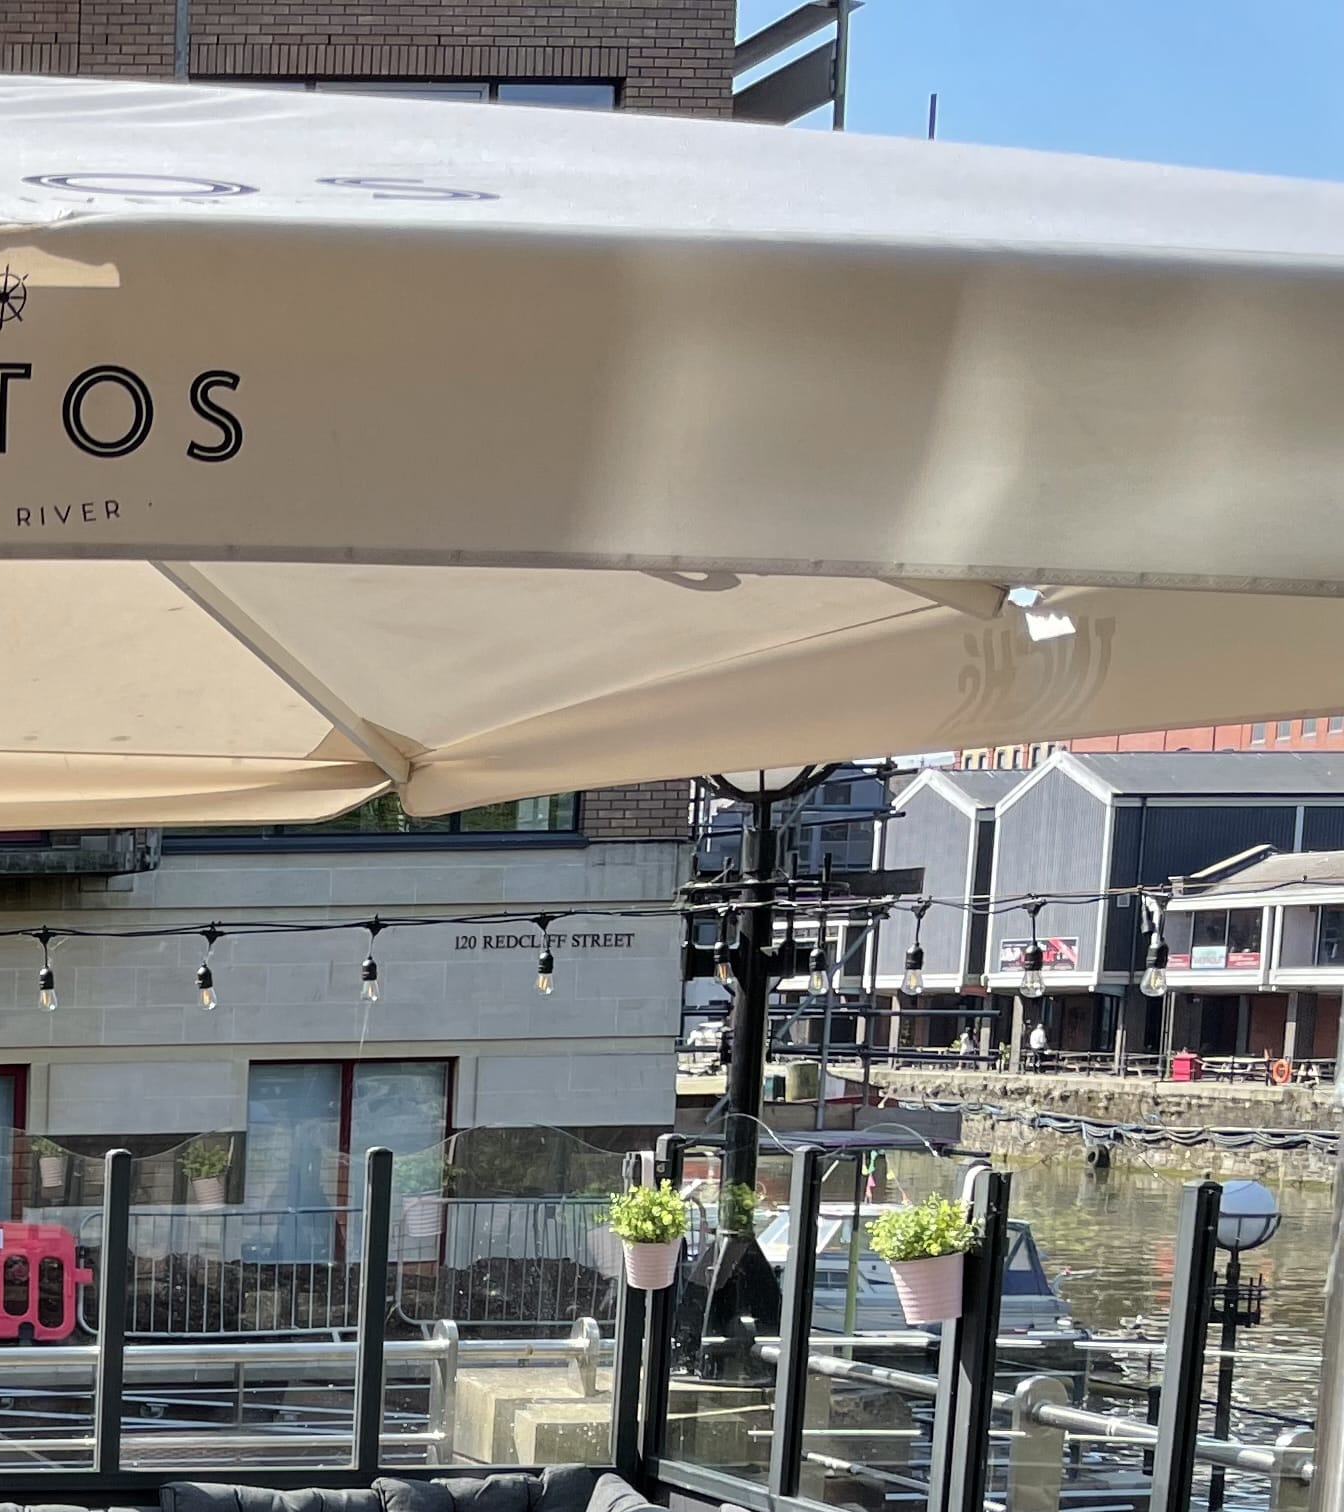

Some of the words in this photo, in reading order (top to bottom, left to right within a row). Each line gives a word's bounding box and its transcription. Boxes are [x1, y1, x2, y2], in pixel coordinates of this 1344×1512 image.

[17, 499, 122, 528] RIVER
[455, 935, 477, 950] 120
[571, 933, 635, 948] STREET
